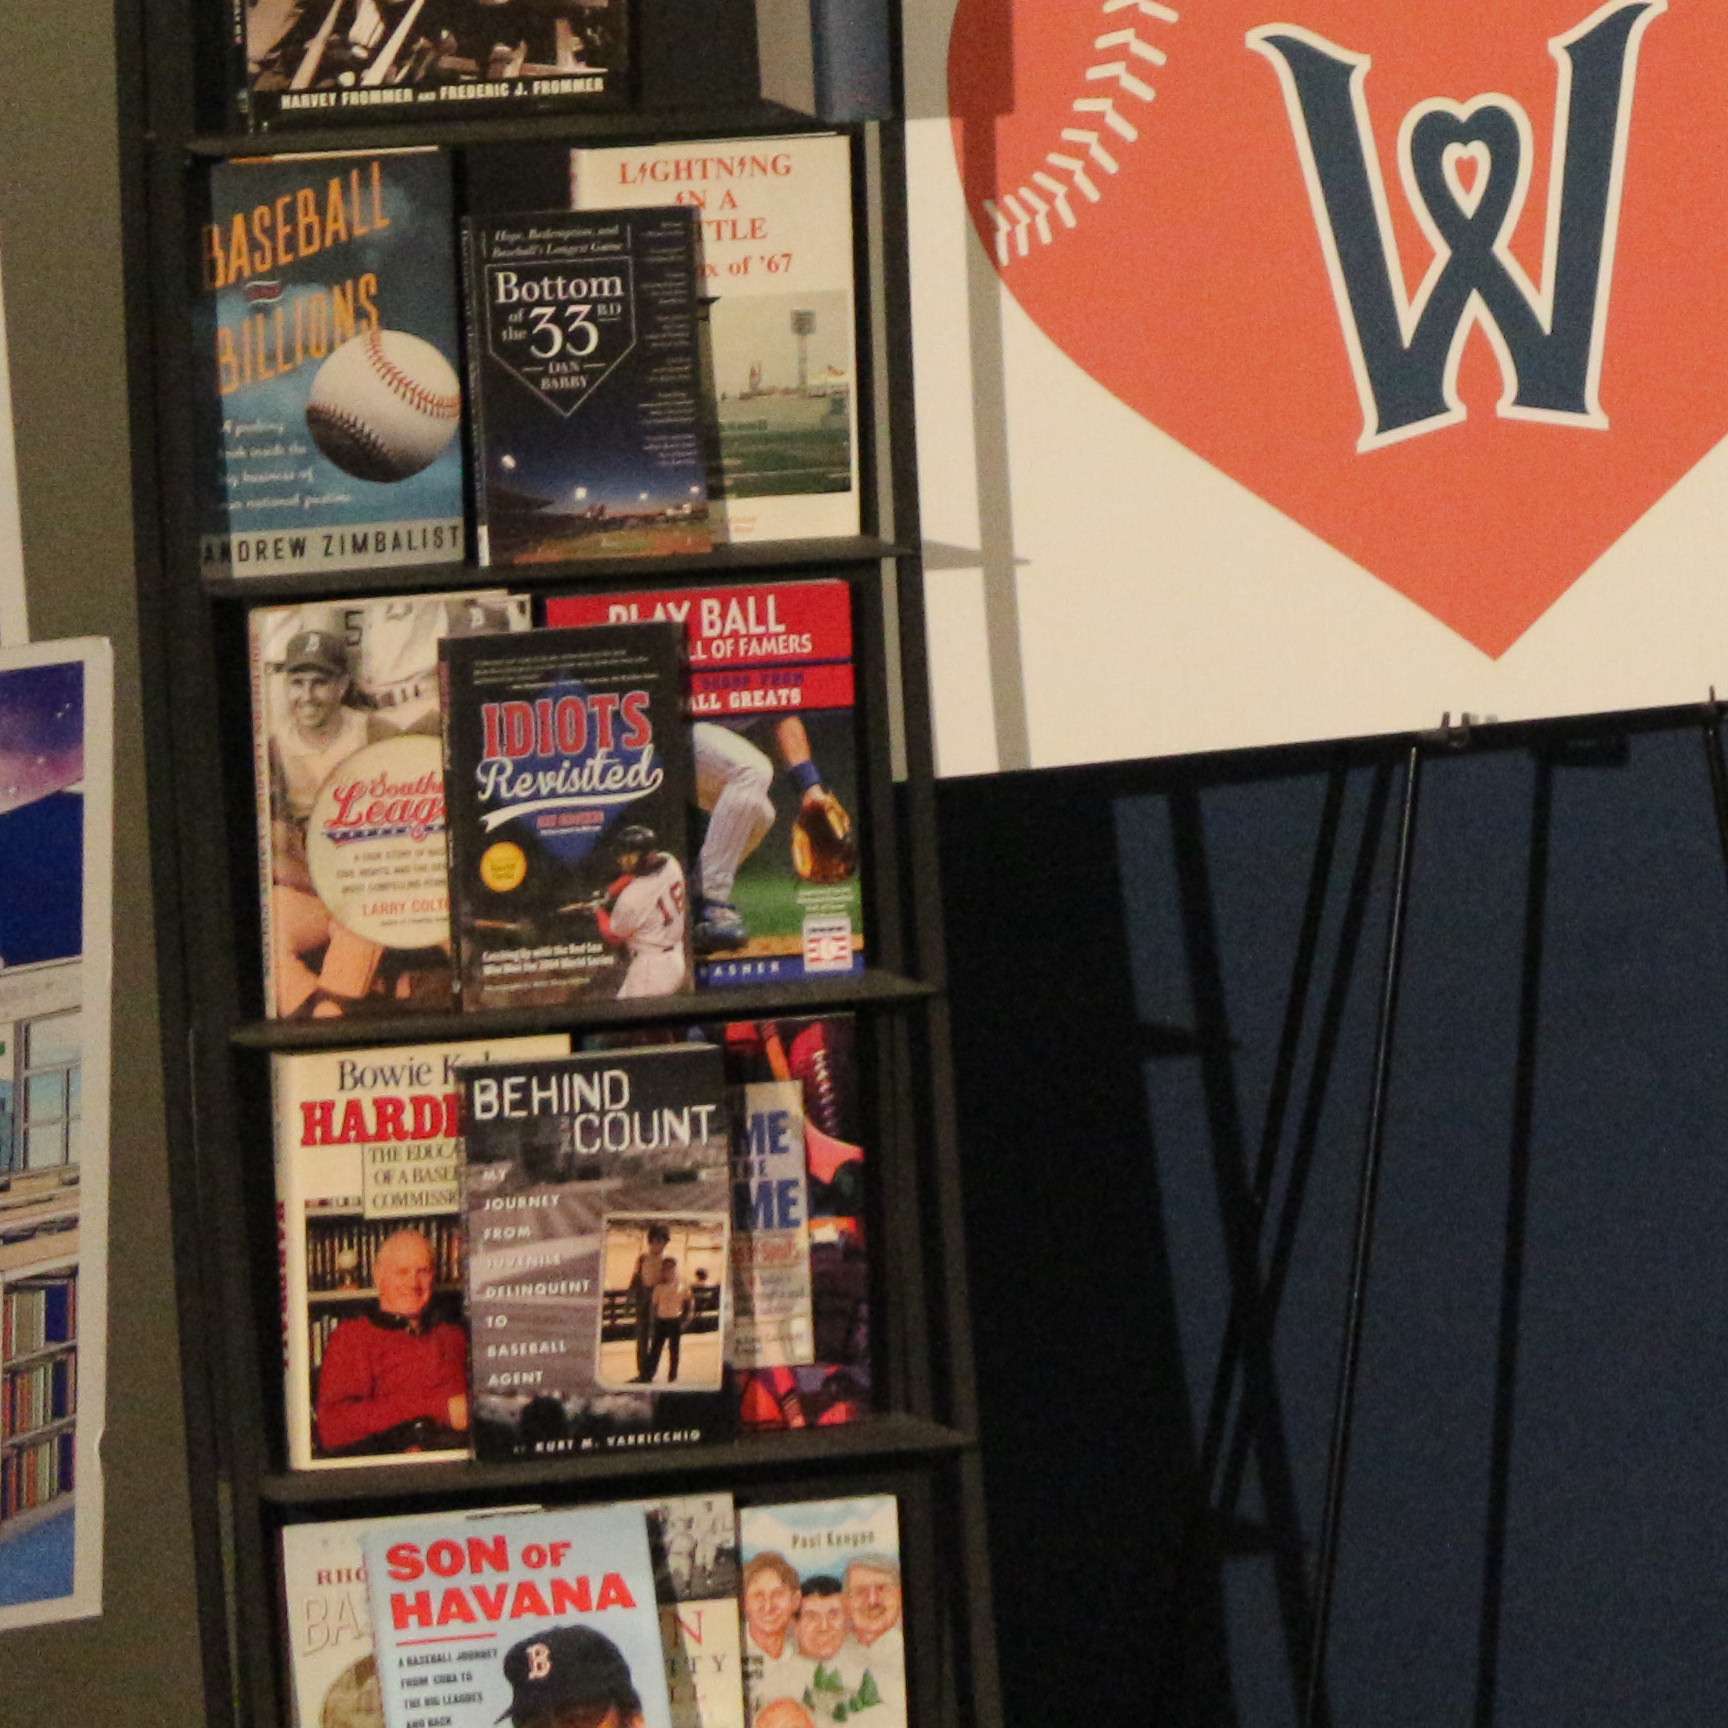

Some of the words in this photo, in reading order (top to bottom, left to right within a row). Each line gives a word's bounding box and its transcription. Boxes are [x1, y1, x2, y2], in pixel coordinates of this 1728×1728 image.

[281, 92, 337, 110] HARVEY
[341, 88, 413, 106] FROMMER
[440, 83, 509, 100] FREDERIC
[514, 83, 527, 96] J.
[532, 77, 604, 95] FROMMER
[719, 189, 738, 210] A
[204, 161, 391, 288] BASEBALL
[729, 255, 752, 276] of
[495, 271, 624, 303] Bottom
[508, 307, 525, 323] of
[217, 273, 380, 395] BILLIONS
[502, 325, 527, 342] the
[549, 361, 581, 374] DAN
[541, 375, 589, 391] BARRY
[203, 535, 306, 565] ANDREW
[323, 525, 460, 558] ZIMBALIST
[701, 594, 786, 638] BALL
[711, 638, 734, 659] OF
[739, 633, 813, 657] FAMERS
[729, 688, 802, 709] GREATS
[481, 690, 652, 761] IDIOTS
[476, 743, 664, 802] Revisited
[338, 1056, 432, 1091] Bowie
[473, 1069, 630, 1120] BEHIND
[574, 1105, 717, 1154] COUNT
[369, 1146, 399, 1163] THE
[374, 1169, 392, 1184] OF
[397, 1168, 408, 1183] A
[484, 1194, 560, 1211] JOURNEY
[484, 1226, 531, 1239] FROM
[485, 1279, 590, 1299] DELINQUENT
[486, 1315, 508, 1328] TO
[487, 1340, 567, 1357] BASEBALL
[488, 1371, 543, 1386] AGENT
[535, 1439, 574, 1453] KURT
[607, 1429, 701, 1446] VARRICCHIO
[386, 1534, 509, 1582] SON
[521, 1541, 572, 1569] OF
[390, 1572, 637, 1630] HAVANA
[525, 1643, 552, 1680] B
[401, 1676, 429, 1689] FROM
